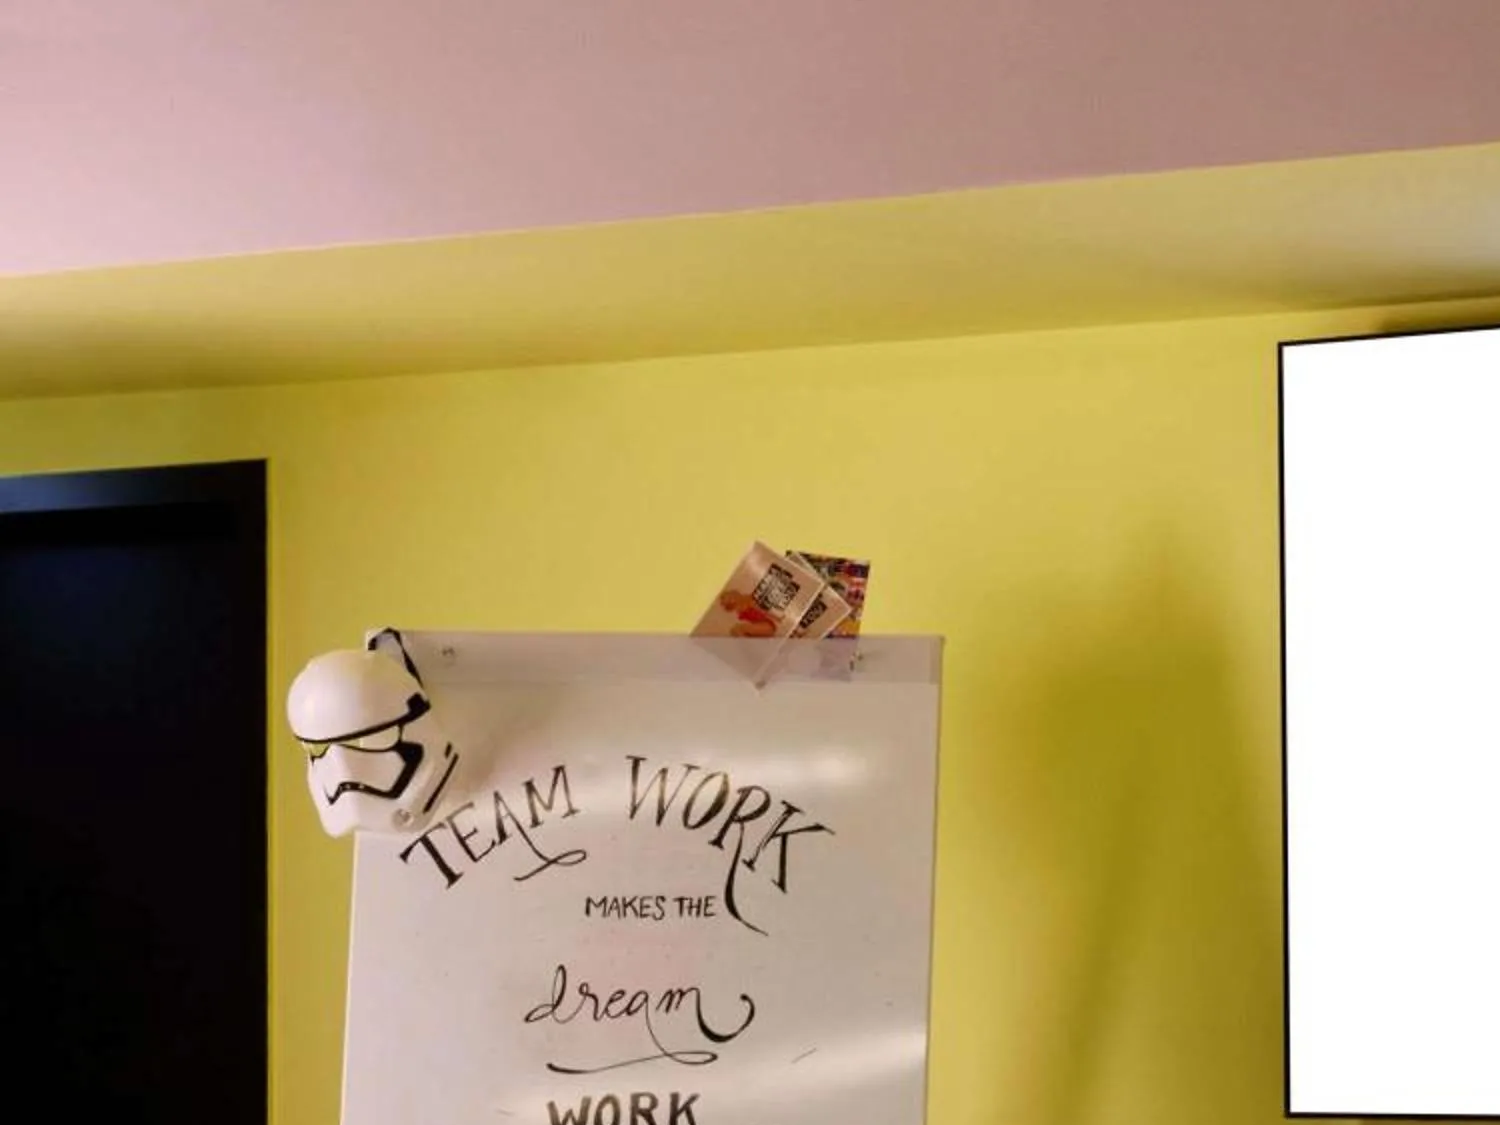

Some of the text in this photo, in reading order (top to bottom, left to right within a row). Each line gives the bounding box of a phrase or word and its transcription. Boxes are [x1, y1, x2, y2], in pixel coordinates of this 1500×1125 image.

[399, 755, 836, 936] TEAM WORK
[585, 895, 716, 921] MAKES THE
[524, 964, 755, 1074] dream
